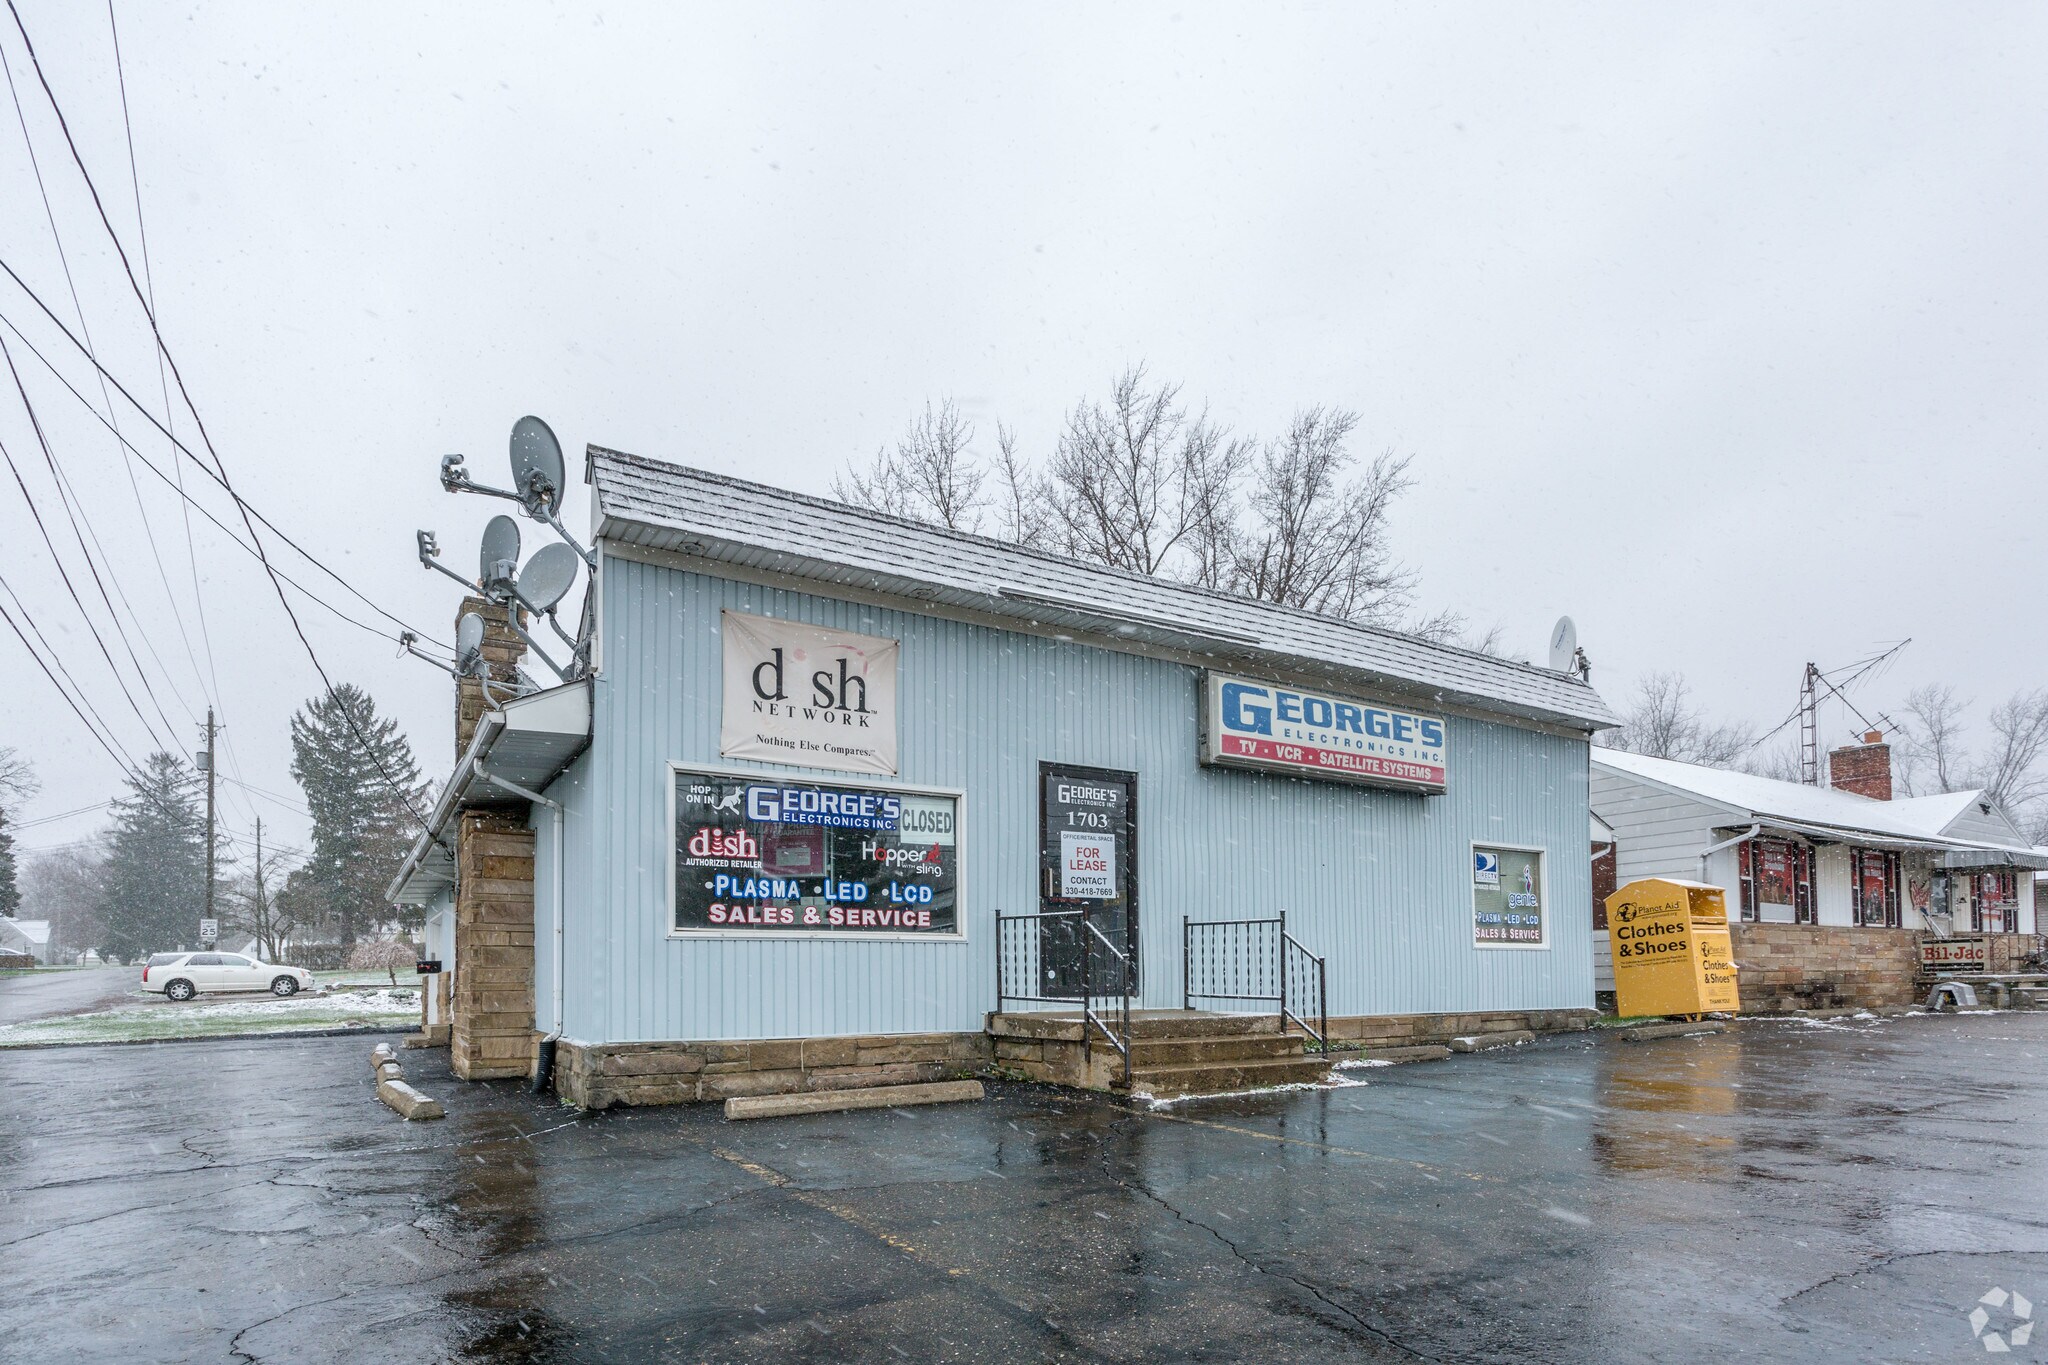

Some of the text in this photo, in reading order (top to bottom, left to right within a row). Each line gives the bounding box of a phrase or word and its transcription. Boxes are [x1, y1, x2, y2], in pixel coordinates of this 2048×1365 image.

[752, 647, 870, 714] dsh
[752, 700, 870, 728] NETWORK
[1221, 682, 1443, 748] GEORGE'S
[756, 734, 871, 757] Nothing Else Compares.
[1284, 727, 1443, 763] ELECTRONICS INC.
[1239, 739, 1432, 780] TV VCR SATELLITE SYSTEMS
[690, 785, 711, 794] HOP
[1058, 784, 1117, 804] GEORGE'S
[686, 794, 714, 804] ON IN
[747, 786, 900, 821] GEORGE'S
[1071, 798, 1106, 807] ELECTRONICS
[783, 812, 896, 830] ELECTRONICS INC.
[902, 808, 952, 834] CLOSED
[1066, 811, 1108, 828] 1703
[688, 827, 759, 859] dish
[862, 841, 926, 867] Hopper
[1076, 846, 1100, 858] FOR
[686, 858, 762, 869] AUTHORIZED RETAILER
[1070, 859, 1107, 871] LEASE
[1070, 876, 1107, 885] CONTACT
[1065, 886, 1113, 896] 330-418-7669
[708, 903, 932, 927] SALES & SERVICE
[1638, 901, 1680, 914] Planet Aid
[1476, 927, 1540, 939] SALES & SERVICE
[1617, 922, 1684, 940] Clothes
[1620, 941, 1687, 957] & Shoes
[1702, 960, 1729, 970] Clothes
[1704, 973, 1730, 984] & Shoes
